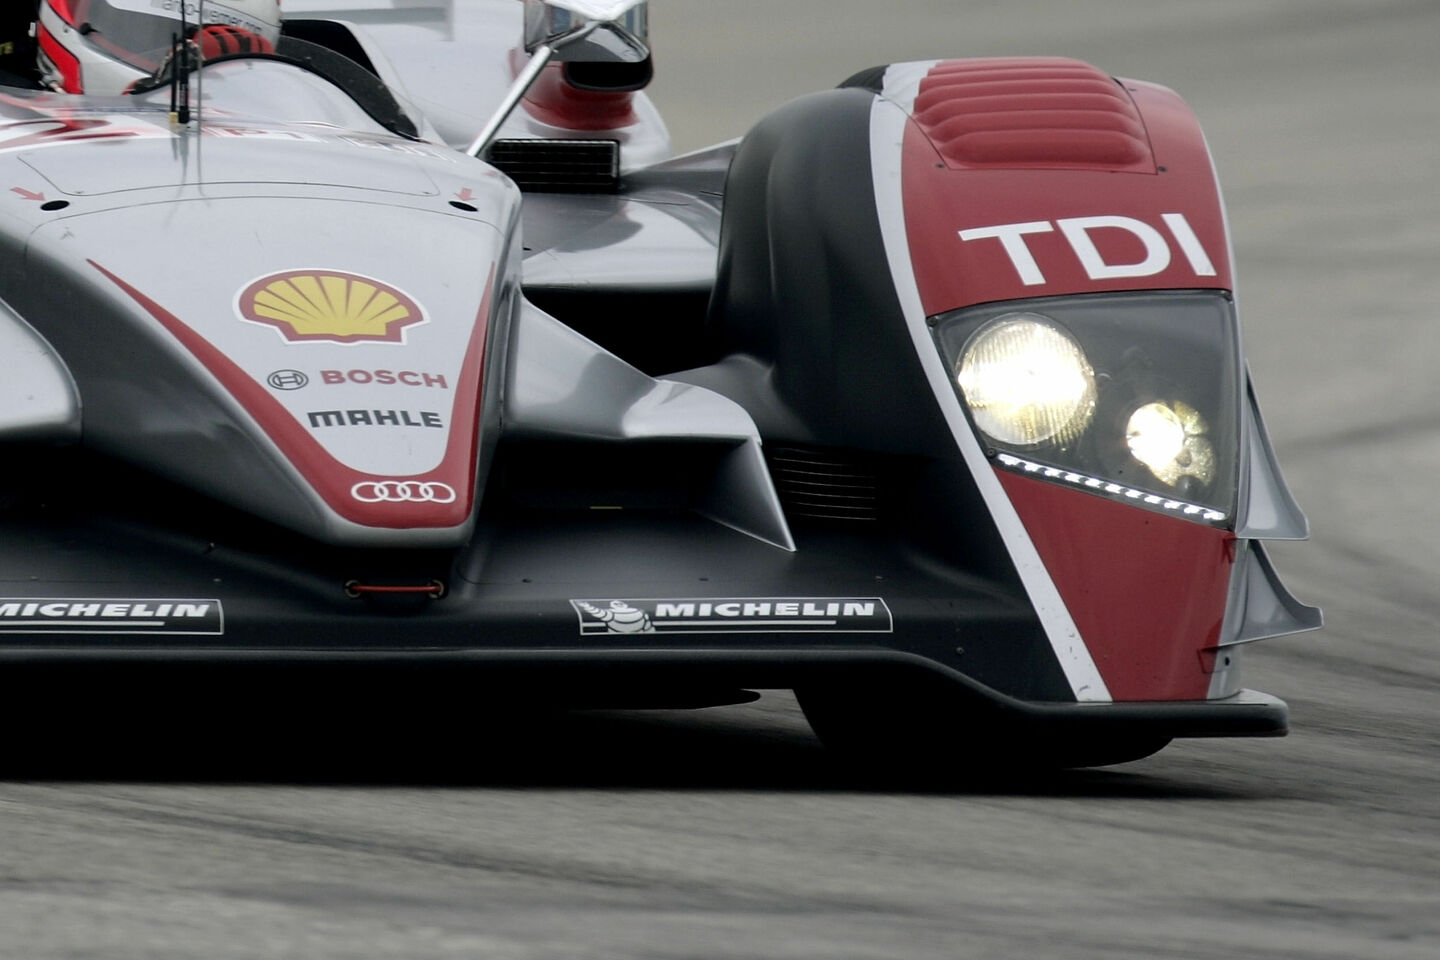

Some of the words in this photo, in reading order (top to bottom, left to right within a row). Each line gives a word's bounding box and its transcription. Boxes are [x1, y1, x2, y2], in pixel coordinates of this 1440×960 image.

[957, 213, 1218, 286] TDI
[320, 369, 448, 389] BOSCH
[307, 409, 444, 428] MAHLE
[655, 603, 875, 617] MICHELIN
